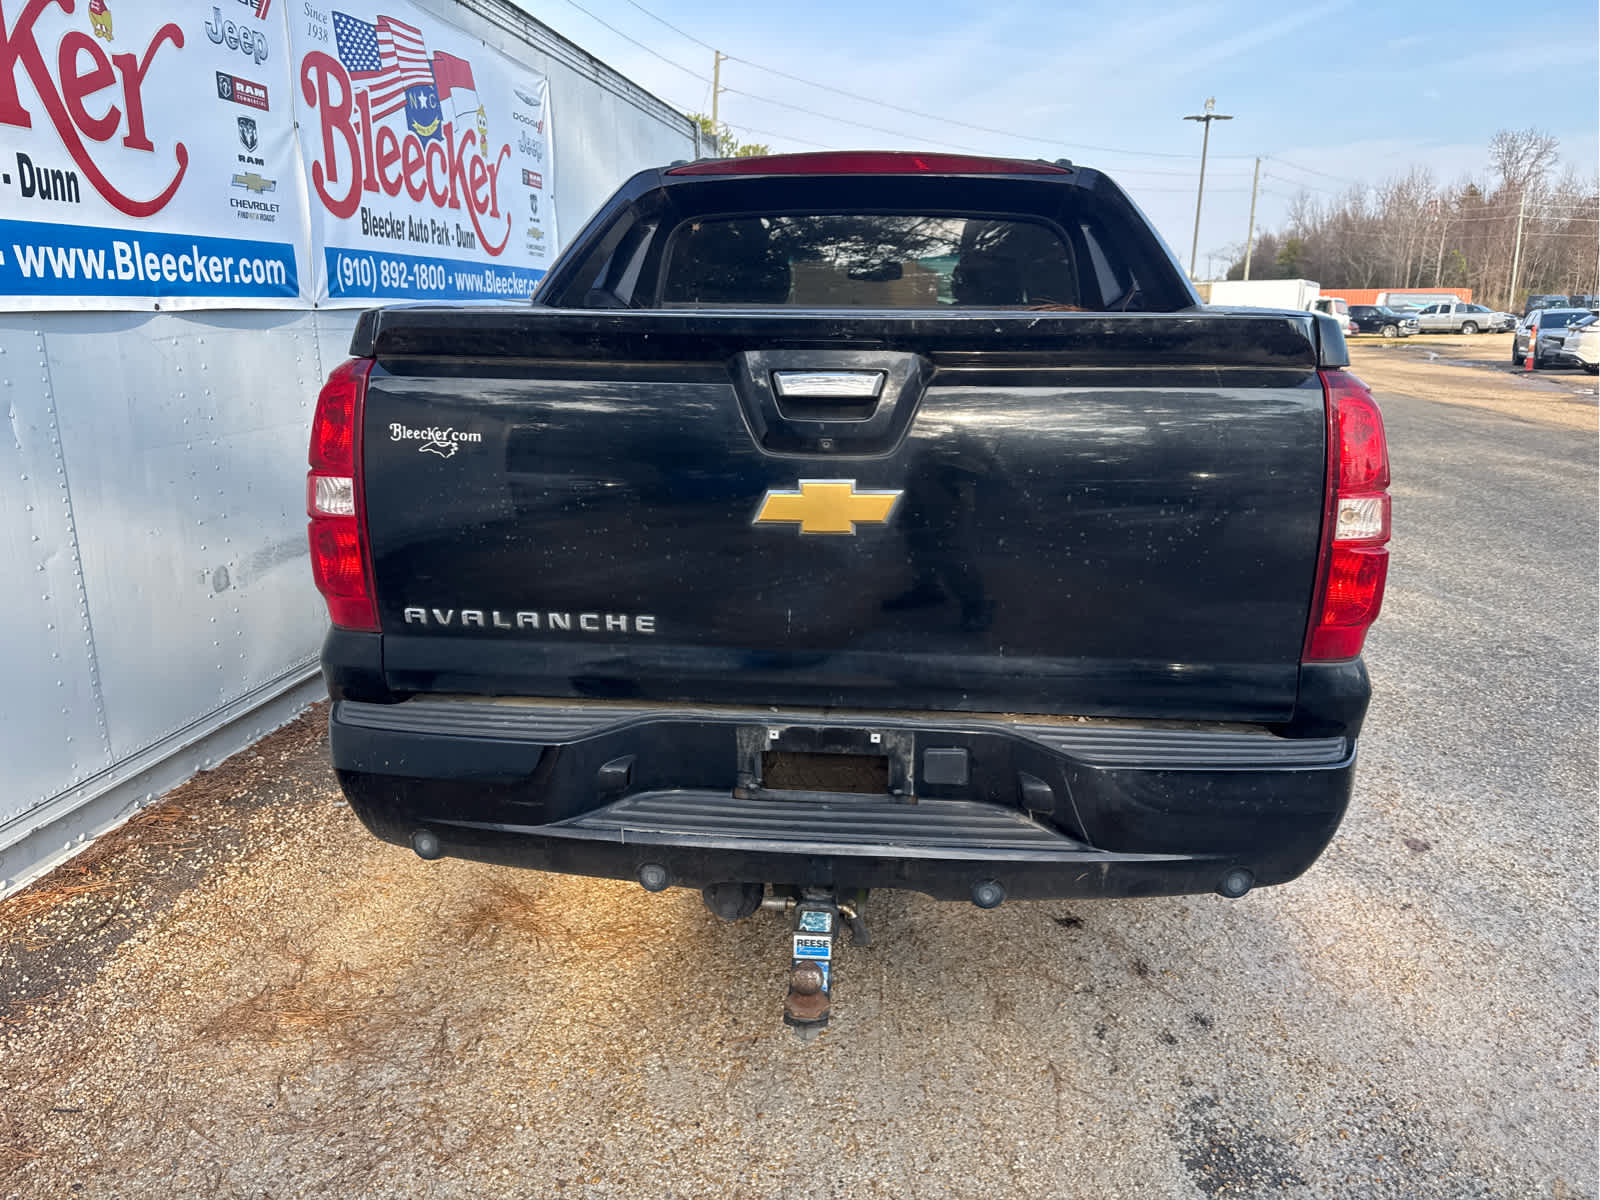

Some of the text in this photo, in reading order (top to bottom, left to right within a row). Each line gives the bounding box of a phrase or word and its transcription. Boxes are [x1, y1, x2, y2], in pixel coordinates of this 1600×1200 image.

[304, 2, 328, 24] Since
[205, 7, 268, 65] Jeep
[307, 22, 328, 42] 1938
[236, 82, 266, 98] RAM
[238, 154, 265, 166] RAM
[16, 152, 81, 203] Dunn
[230, 198, 280, 213] CHEVROLET
[361, 206, 405, 240] Bleecker
[408, 214, 430, 243] Auto
[430, 218, 451, 247] Park
[455, 223, 476, 249] Dunn
[12, 240, 286, 285] www.Bleecker.com
[336, 252, 377, 294] (910)
[380, 259, 446, 291] 892-1800
[404, 607, 656, 632] AVALANCHE
[796, 938, 830, 948] REESE
